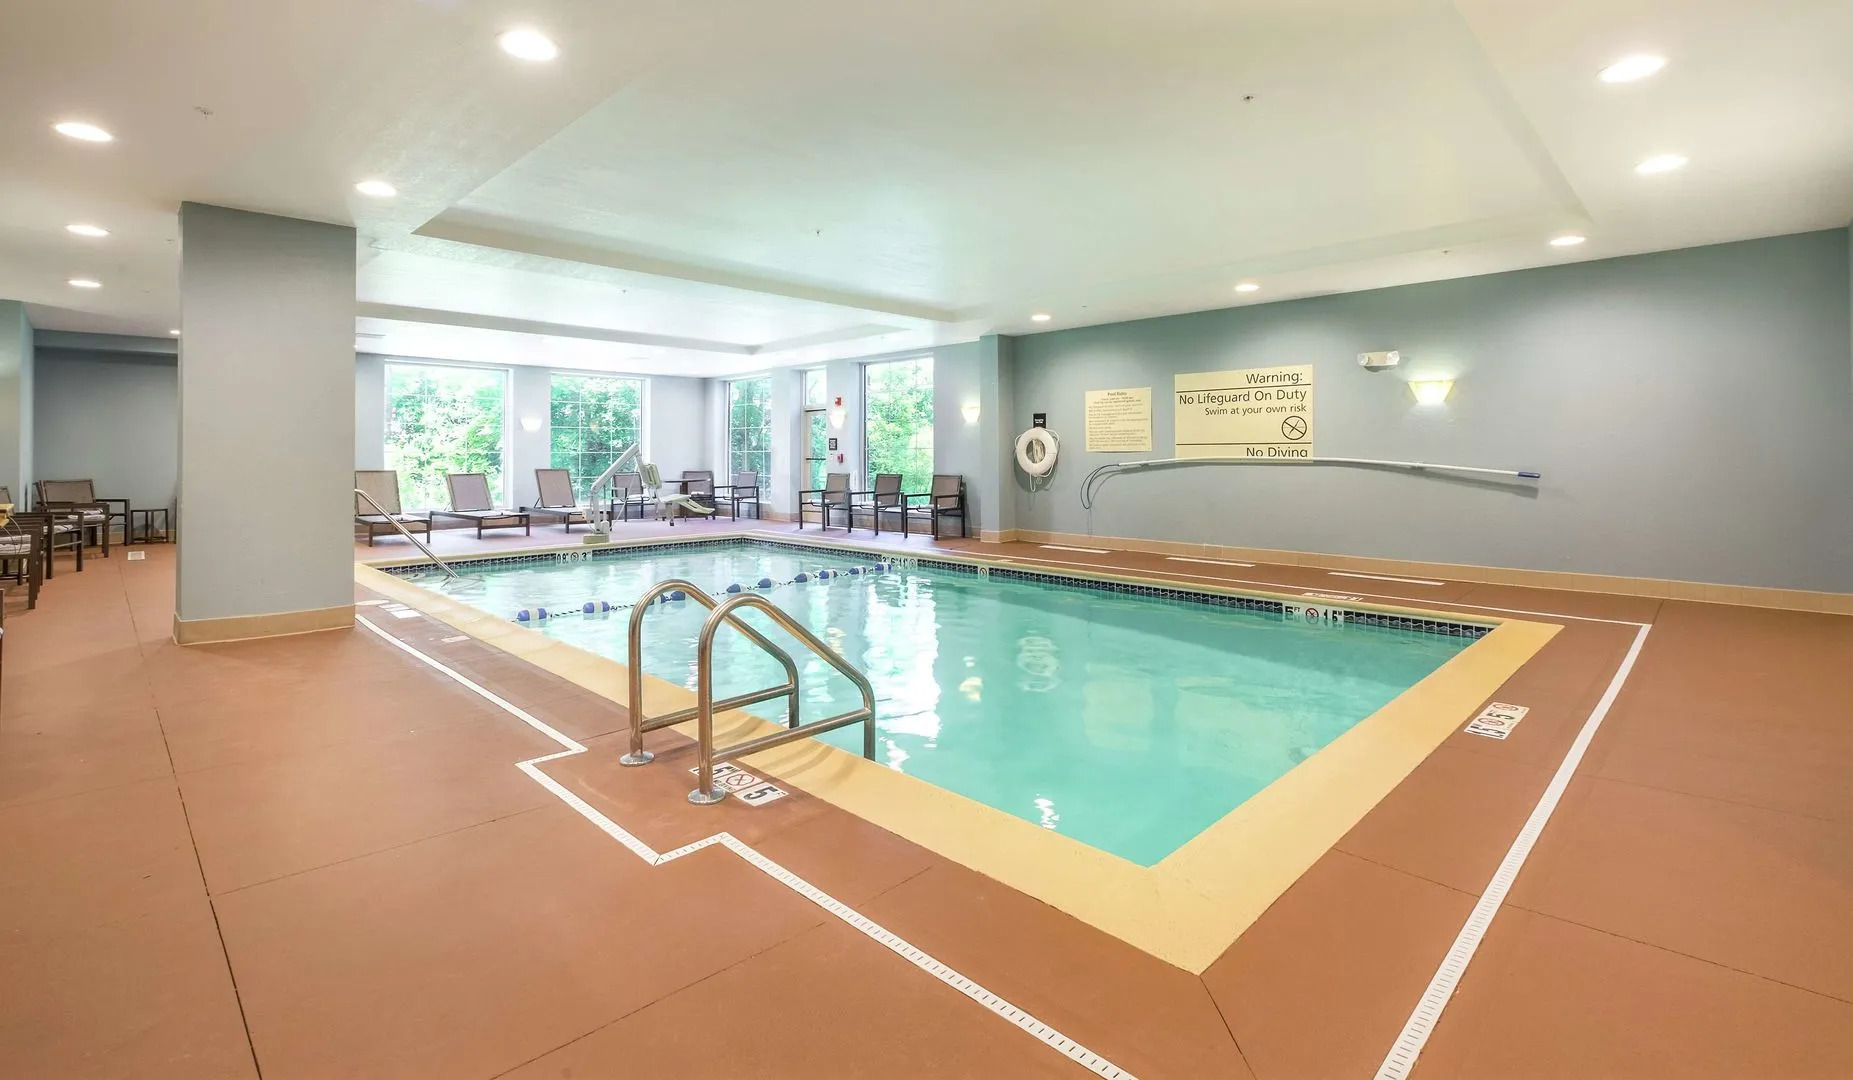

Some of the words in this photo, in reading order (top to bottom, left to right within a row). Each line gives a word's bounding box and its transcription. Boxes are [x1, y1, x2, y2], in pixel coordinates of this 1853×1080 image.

[1245, 371, 1303, 384] Warning:
[1179, 394, 1194, 405] No
[1197, 390, 1250, 406] Lifeguard
[1254, 390, 1272, 401] On
[1276, 389, 1307, 401] Duty
[1204, 406, 1228, 416] Swim
[1230, 406, 1240, 415] at
[1242, 406, 1262, 417] your
[1265, 405, 1287, 414] own
[1290, 403, 1307, 413] risk
[1246, 447, 1264, 457] No
